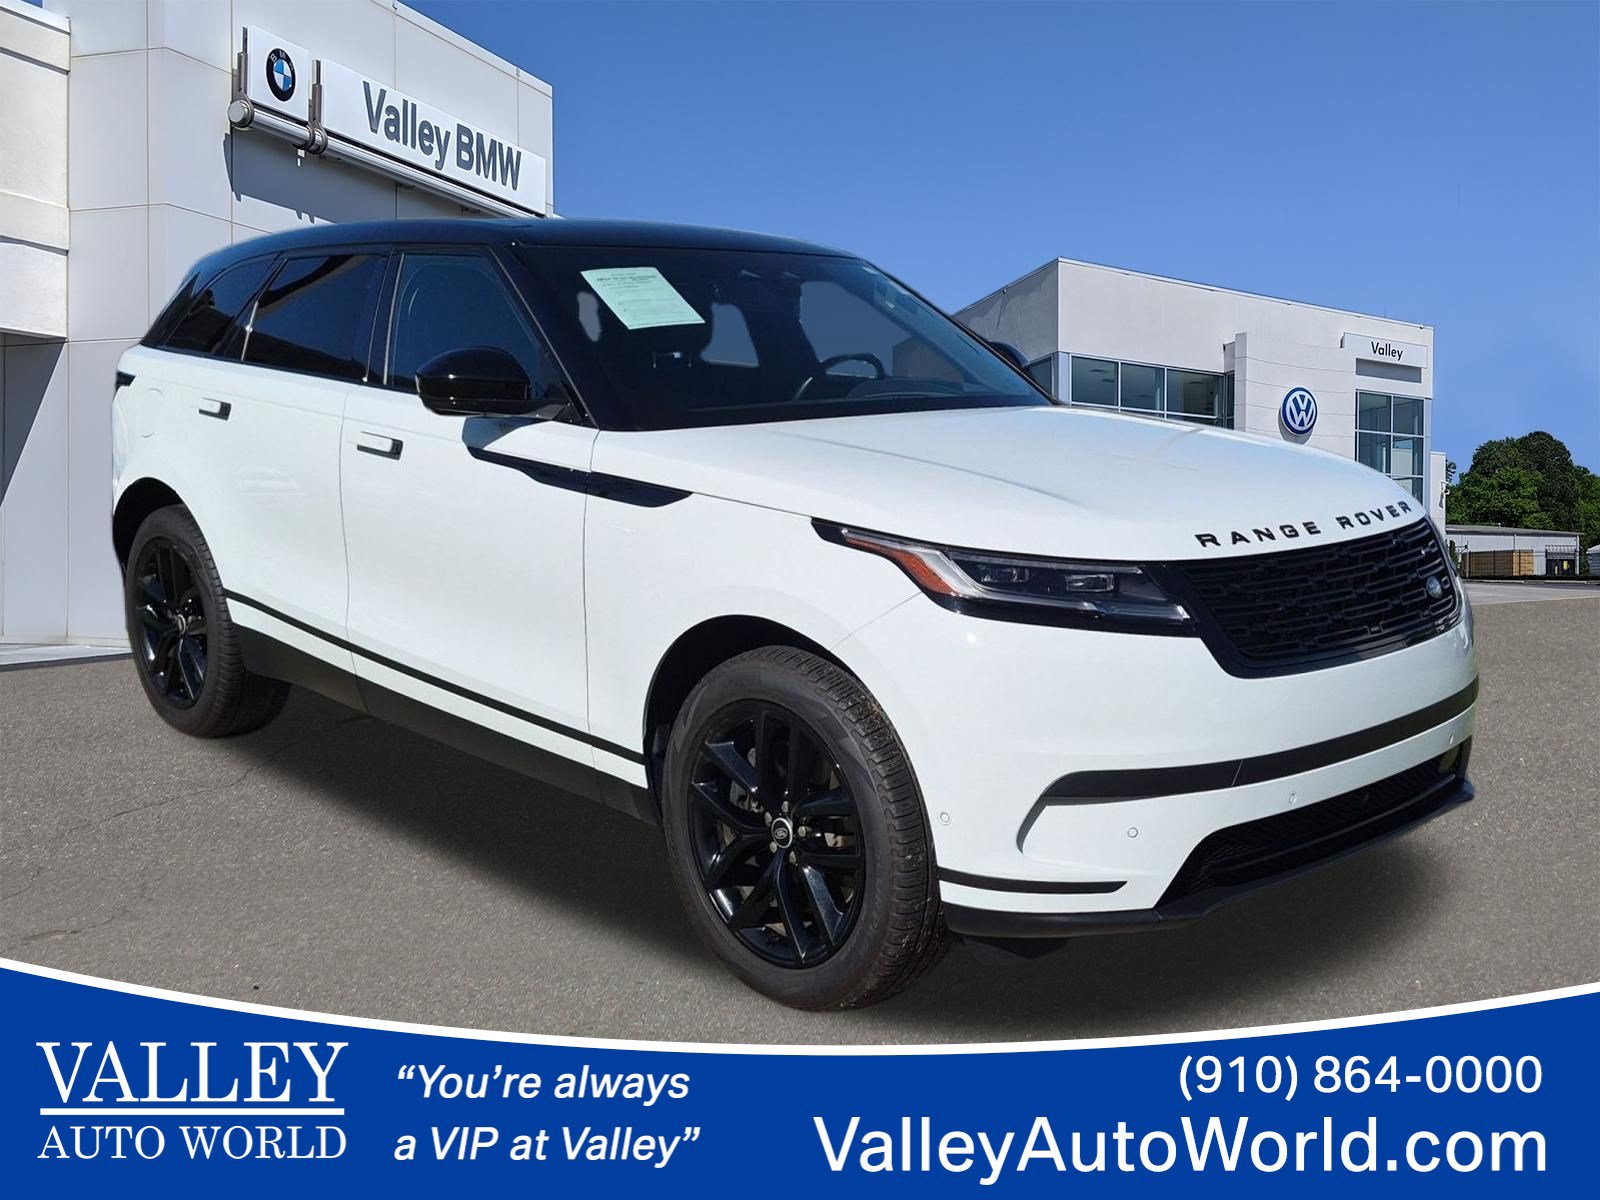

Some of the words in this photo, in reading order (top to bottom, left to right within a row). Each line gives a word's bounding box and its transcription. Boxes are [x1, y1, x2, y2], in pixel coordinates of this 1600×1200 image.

[362, 80, 451, 170] Valley
[455, 122, 522, 191] BMW
[1371, 341, 1403, 361] Valley
[1195, 521, 1321, 548] RANGE
[1335, 500, 1412, 530] ROVER
